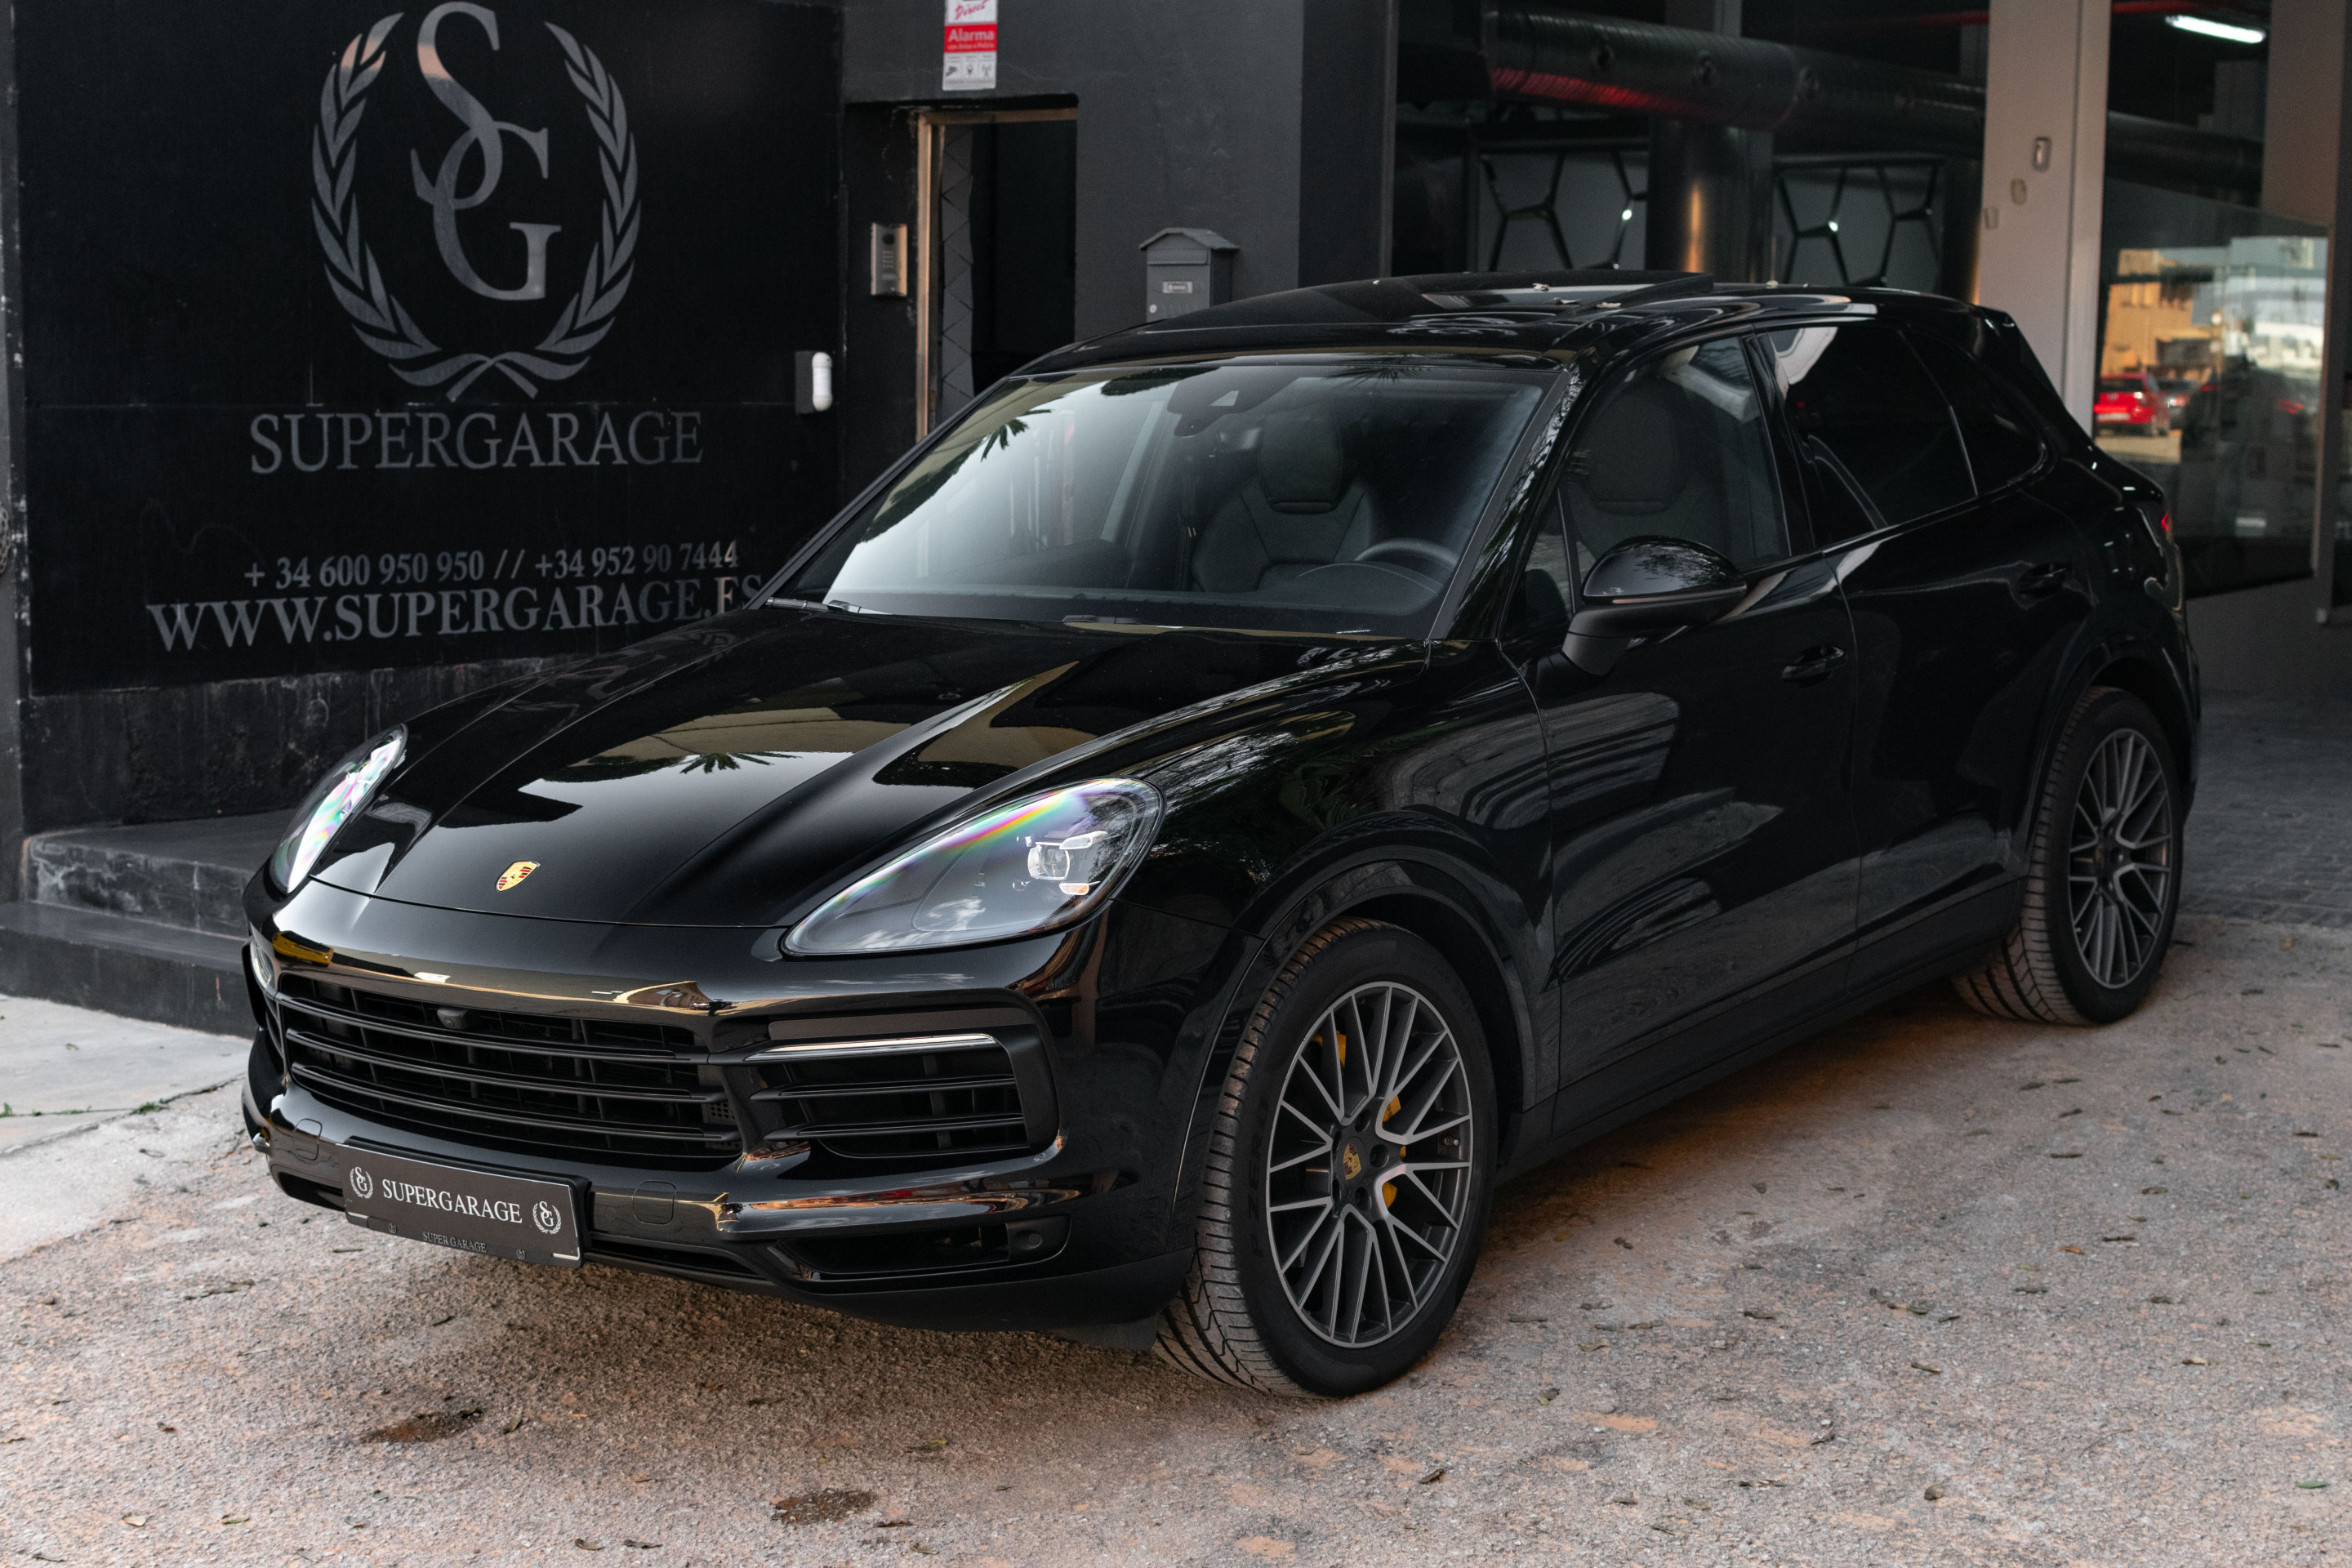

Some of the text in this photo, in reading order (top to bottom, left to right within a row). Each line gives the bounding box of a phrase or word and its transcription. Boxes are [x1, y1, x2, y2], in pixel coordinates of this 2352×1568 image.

[948, 28, 994, 42] Alarma
[249, 411, 704, 474] SUPERGARAGE
[275, 557, 310, 590] 34
[318, 555, 371, 586] 600
[380, 553, 429, 585] 950
[437, 550, 484, 581] 950
[592, 545, 636, 575] 952
[643, 543, 671, 572] 90
[679, 540, 738, 571] 7444
[382, 1178, 523, 1223] SUPERGARAGE
